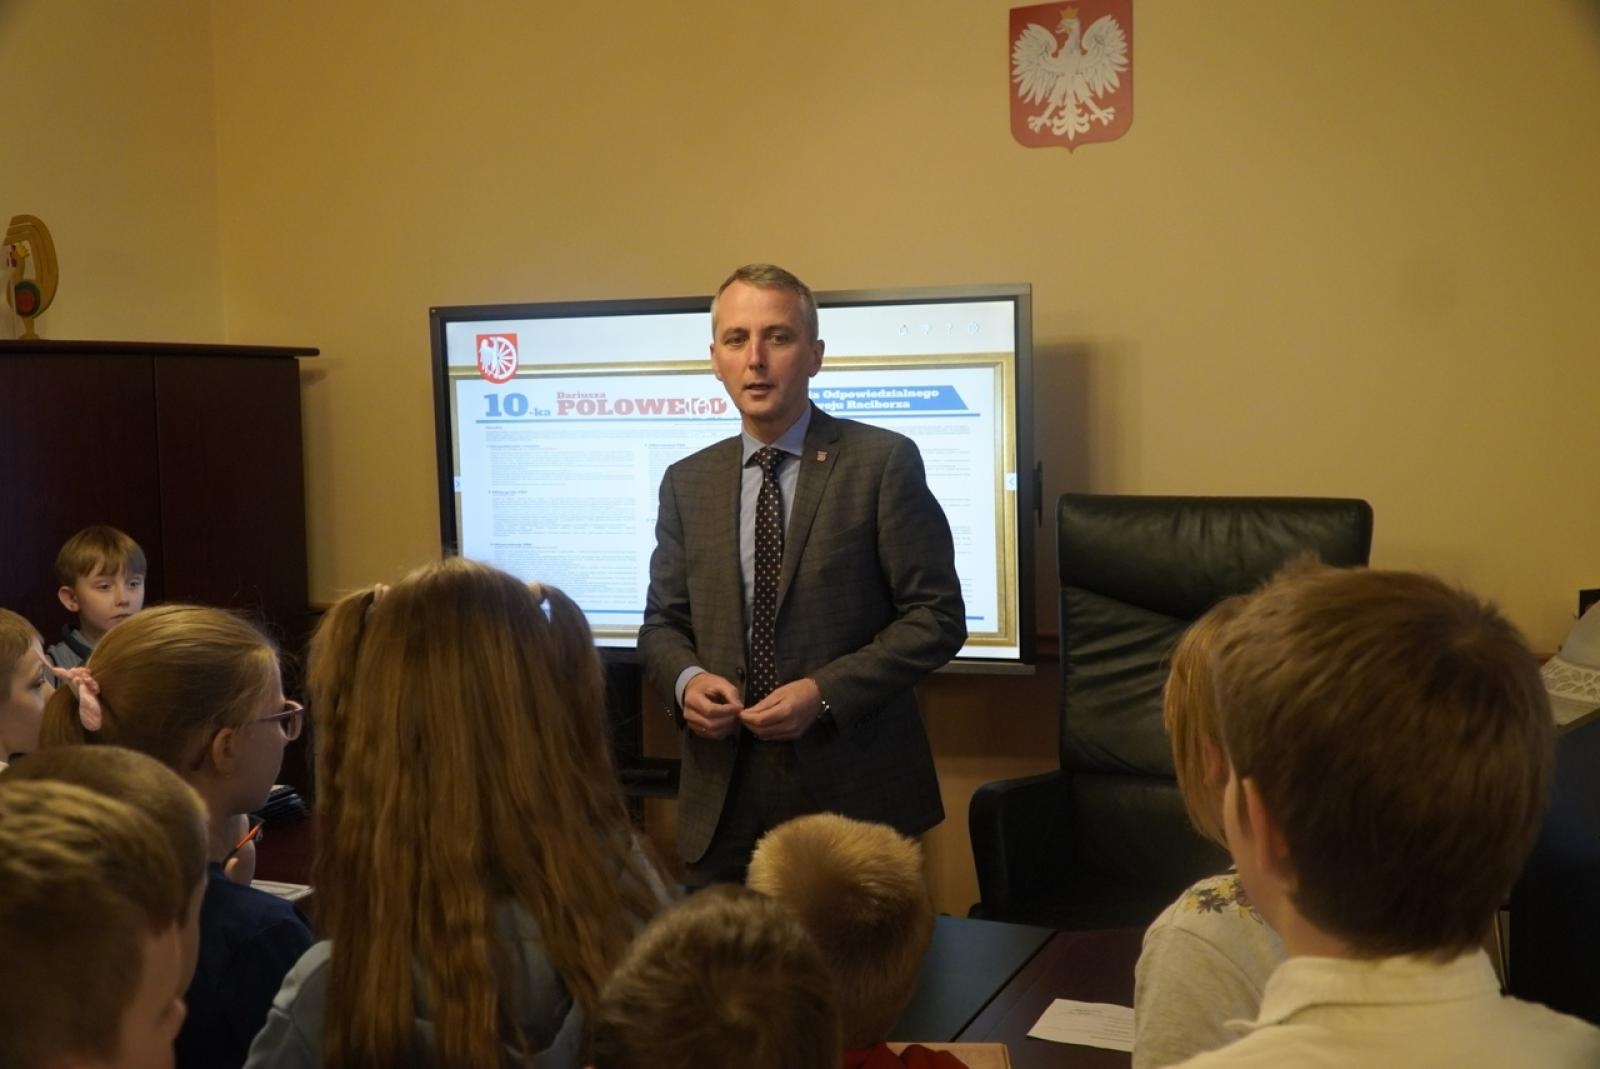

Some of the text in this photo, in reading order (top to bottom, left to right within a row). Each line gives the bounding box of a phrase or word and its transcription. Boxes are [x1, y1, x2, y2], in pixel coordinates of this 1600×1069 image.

[556, 391, 606, 399] Dariusza
[823, 389, 939, 400] Odpowiedzialnego
[815, 400, 911, 410] woju Raciborza
